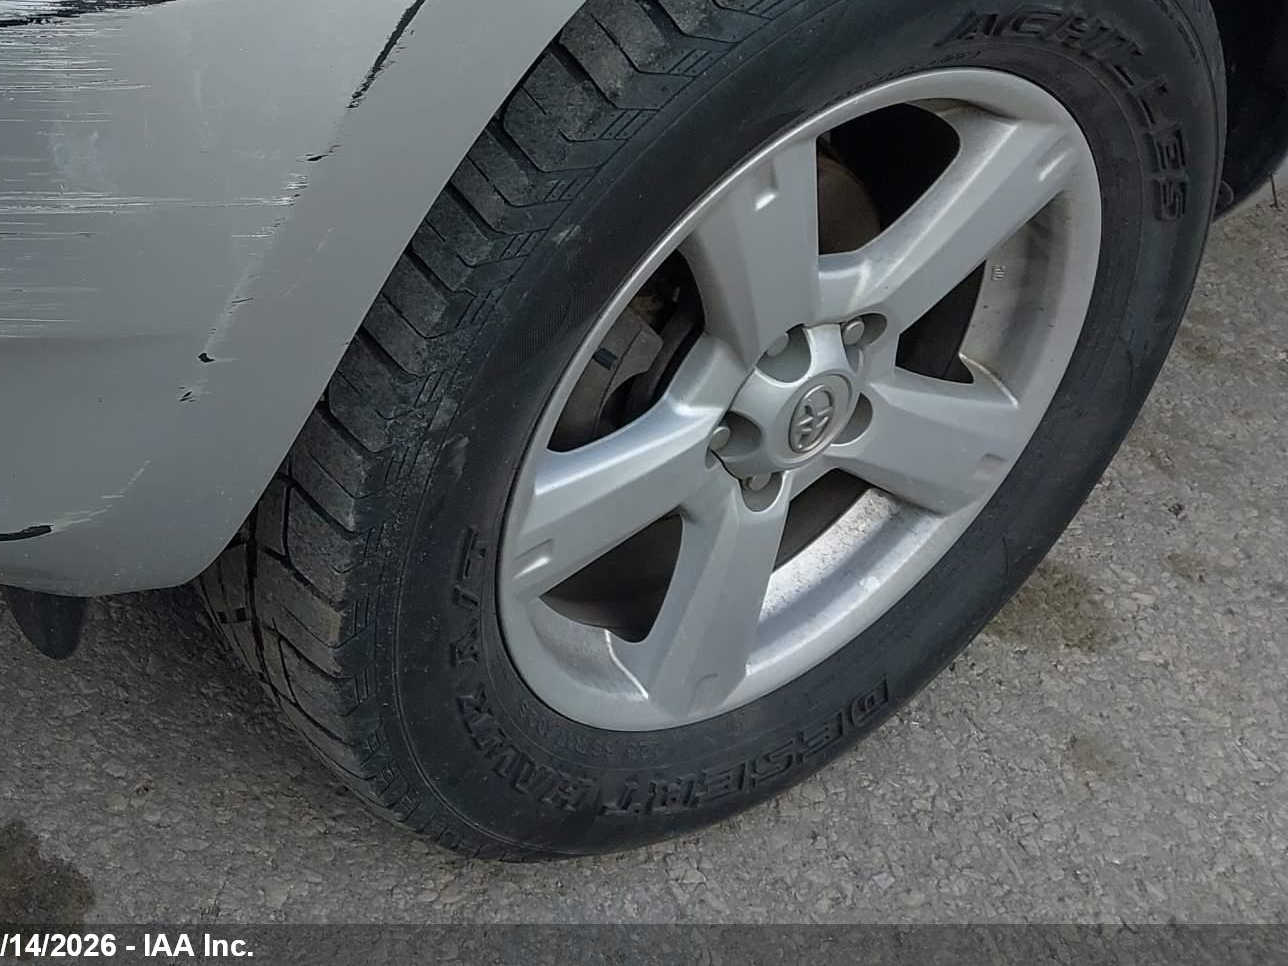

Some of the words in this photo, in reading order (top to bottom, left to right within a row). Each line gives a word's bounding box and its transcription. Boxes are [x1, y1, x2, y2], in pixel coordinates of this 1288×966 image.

[933, 1, 1187, 221] ACHILLES
[455, 688, 600, 812] HAWK
[599, 678, 891, 818] DESERT
